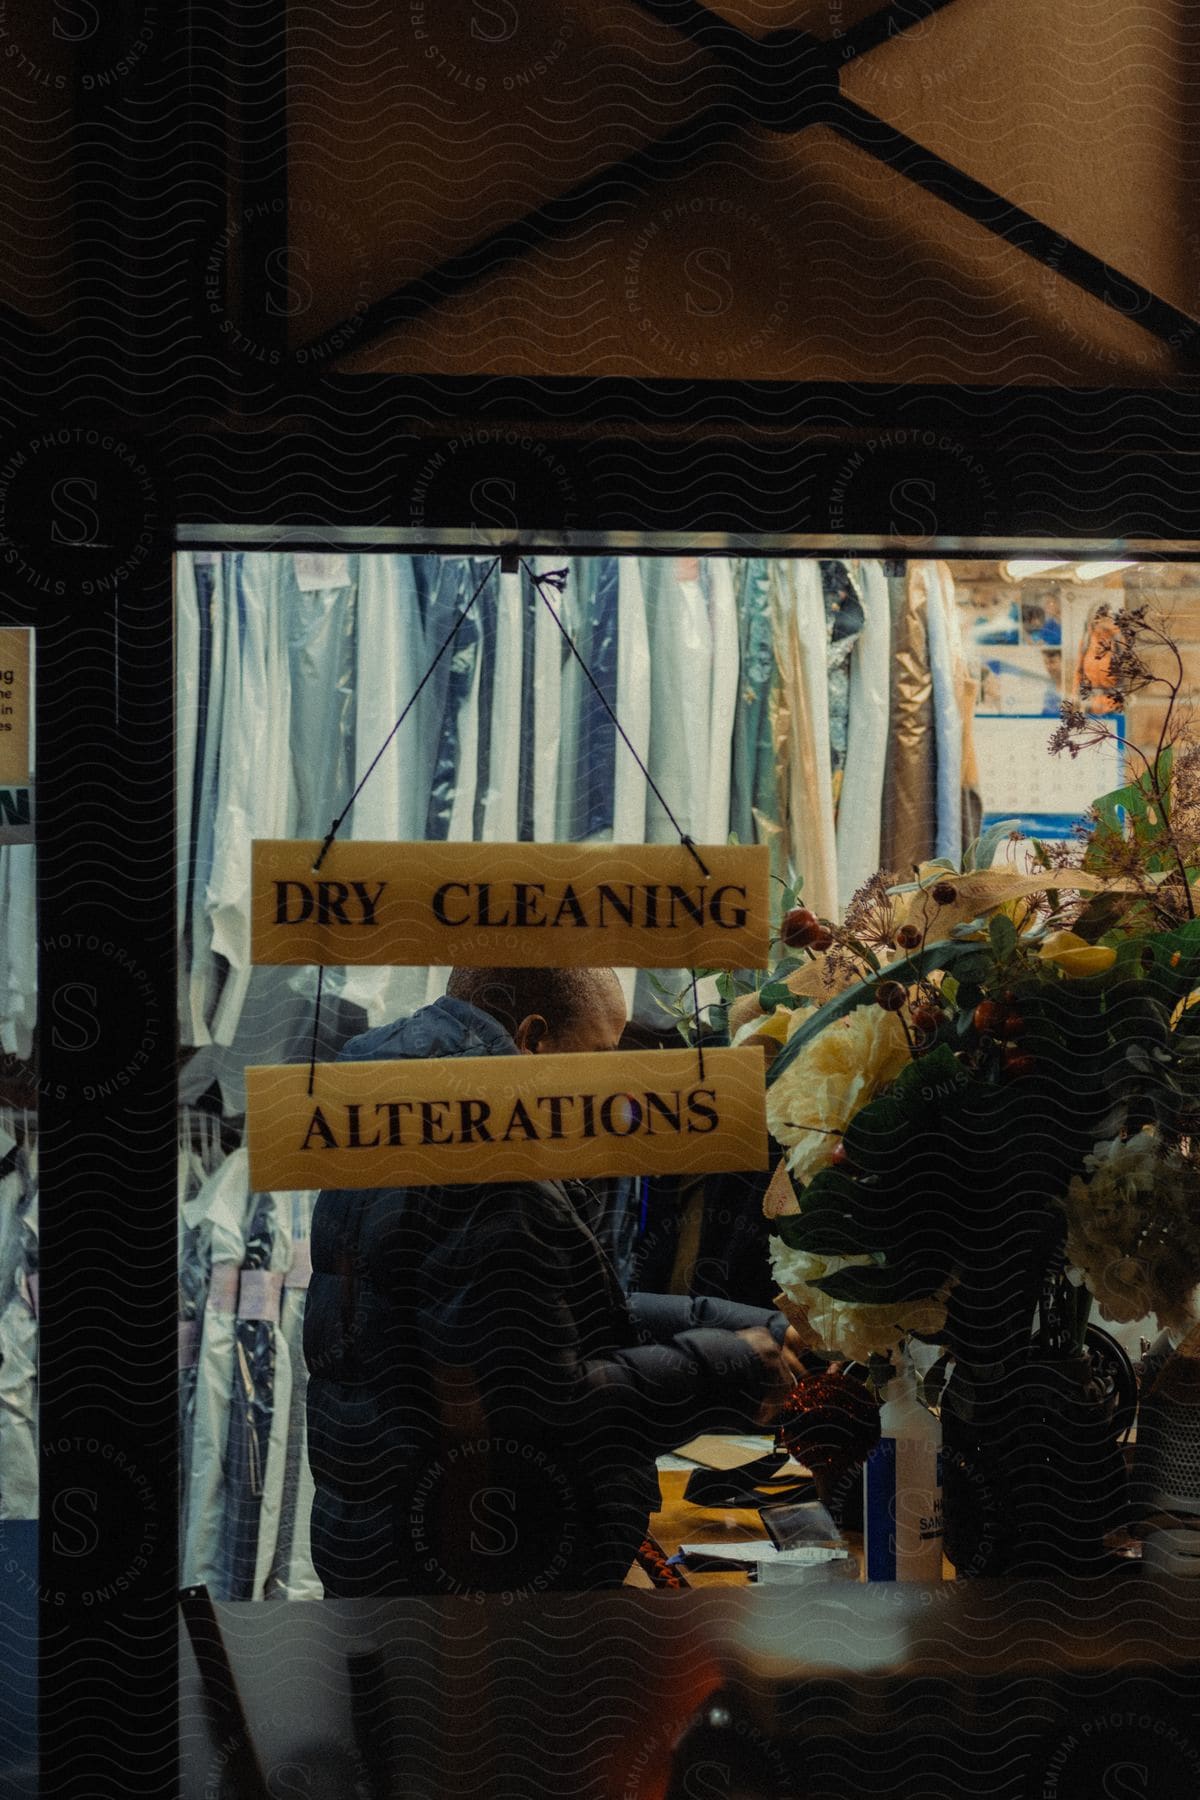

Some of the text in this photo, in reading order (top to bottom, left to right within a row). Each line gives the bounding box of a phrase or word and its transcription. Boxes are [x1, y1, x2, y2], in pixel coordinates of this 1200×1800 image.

[273, 881, 749, 930] DRY CLEANING
[301, 1088, 720, 1150] ALTERATIONS
